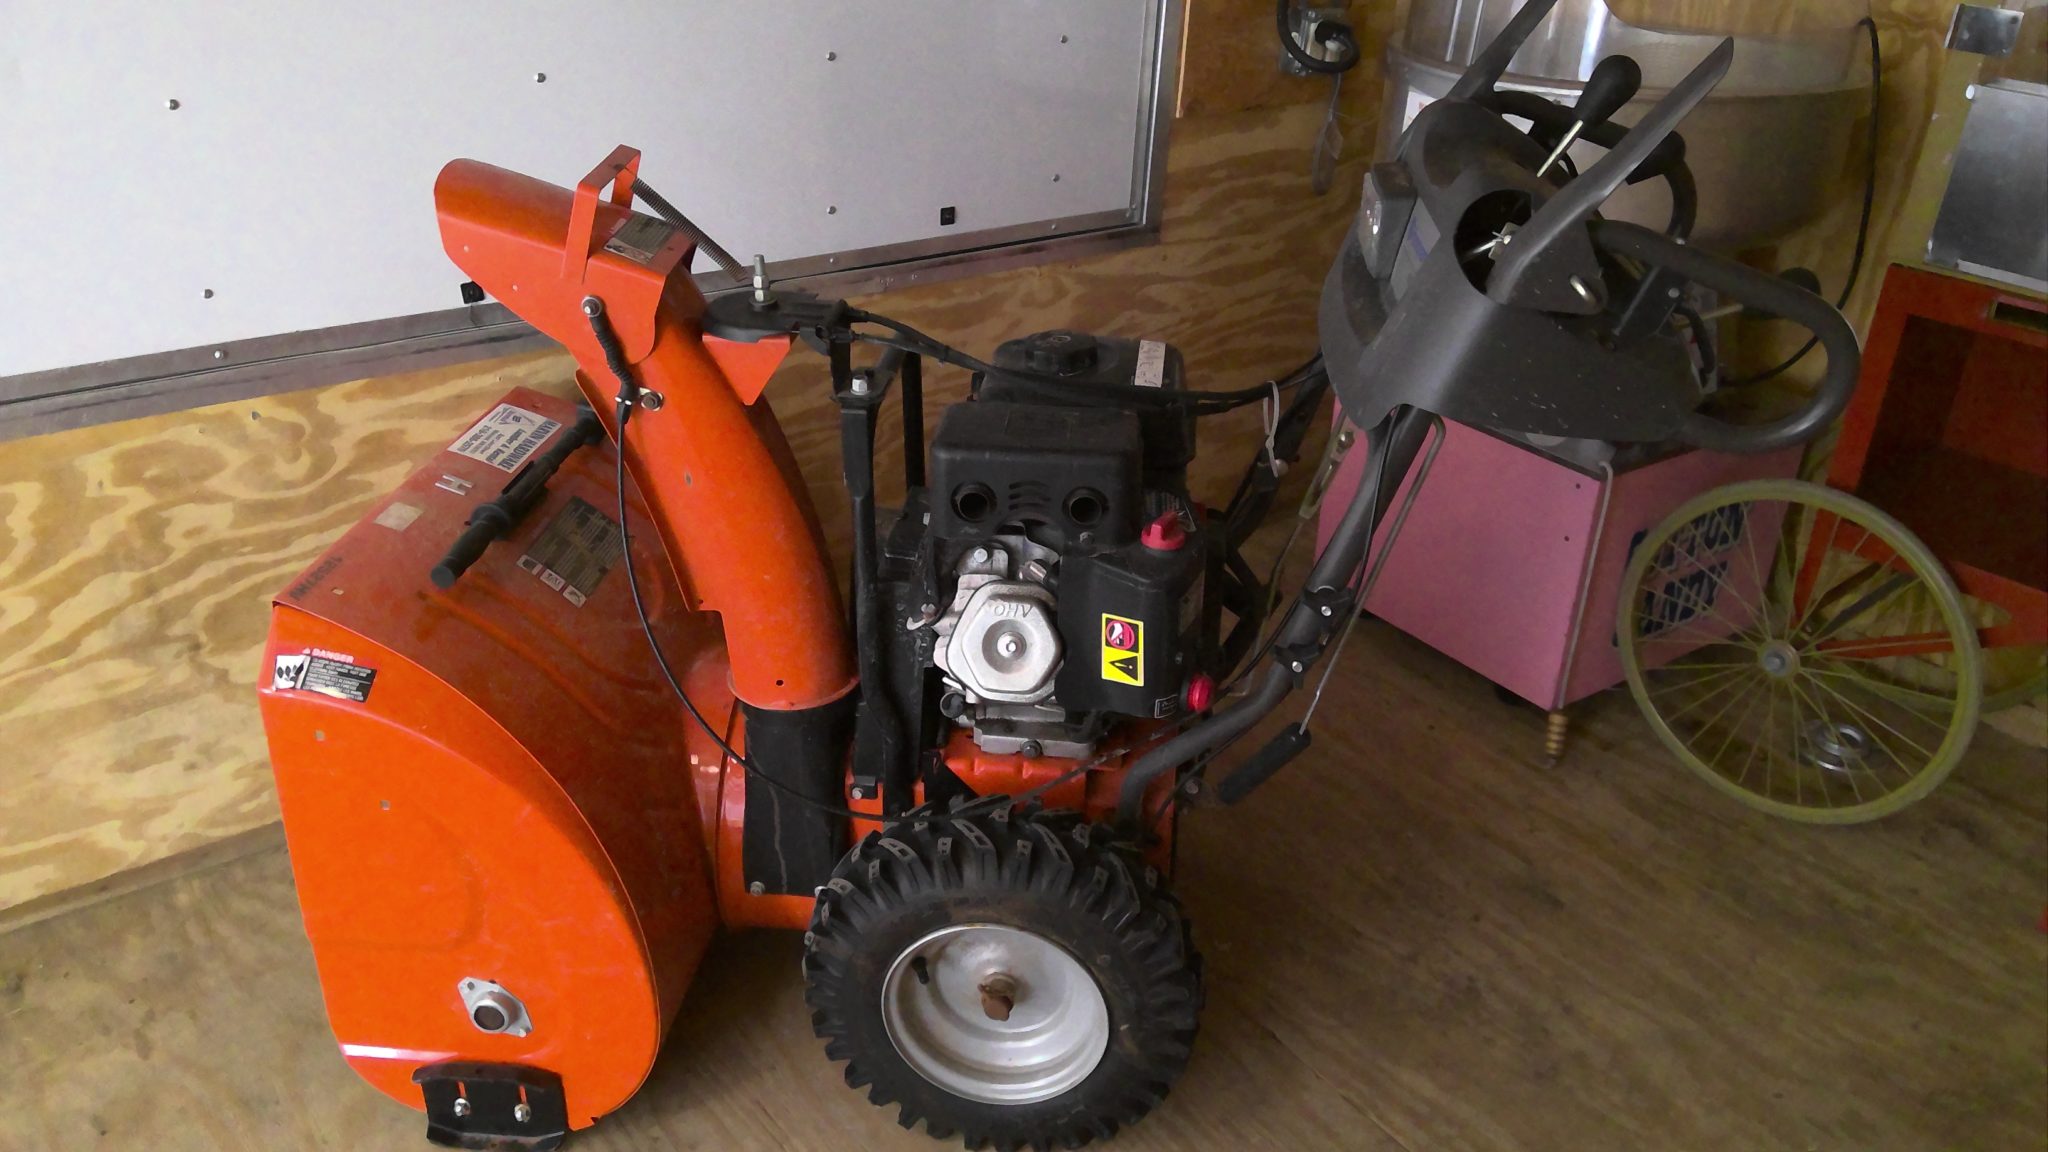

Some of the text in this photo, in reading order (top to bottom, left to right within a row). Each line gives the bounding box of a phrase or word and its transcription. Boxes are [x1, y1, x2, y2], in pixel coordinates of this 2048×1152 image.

[497, 437, 538, 470] HARDWARE
[994, 603, 1034, 618] OHV
[312, 648, 354, 664] DANGER
